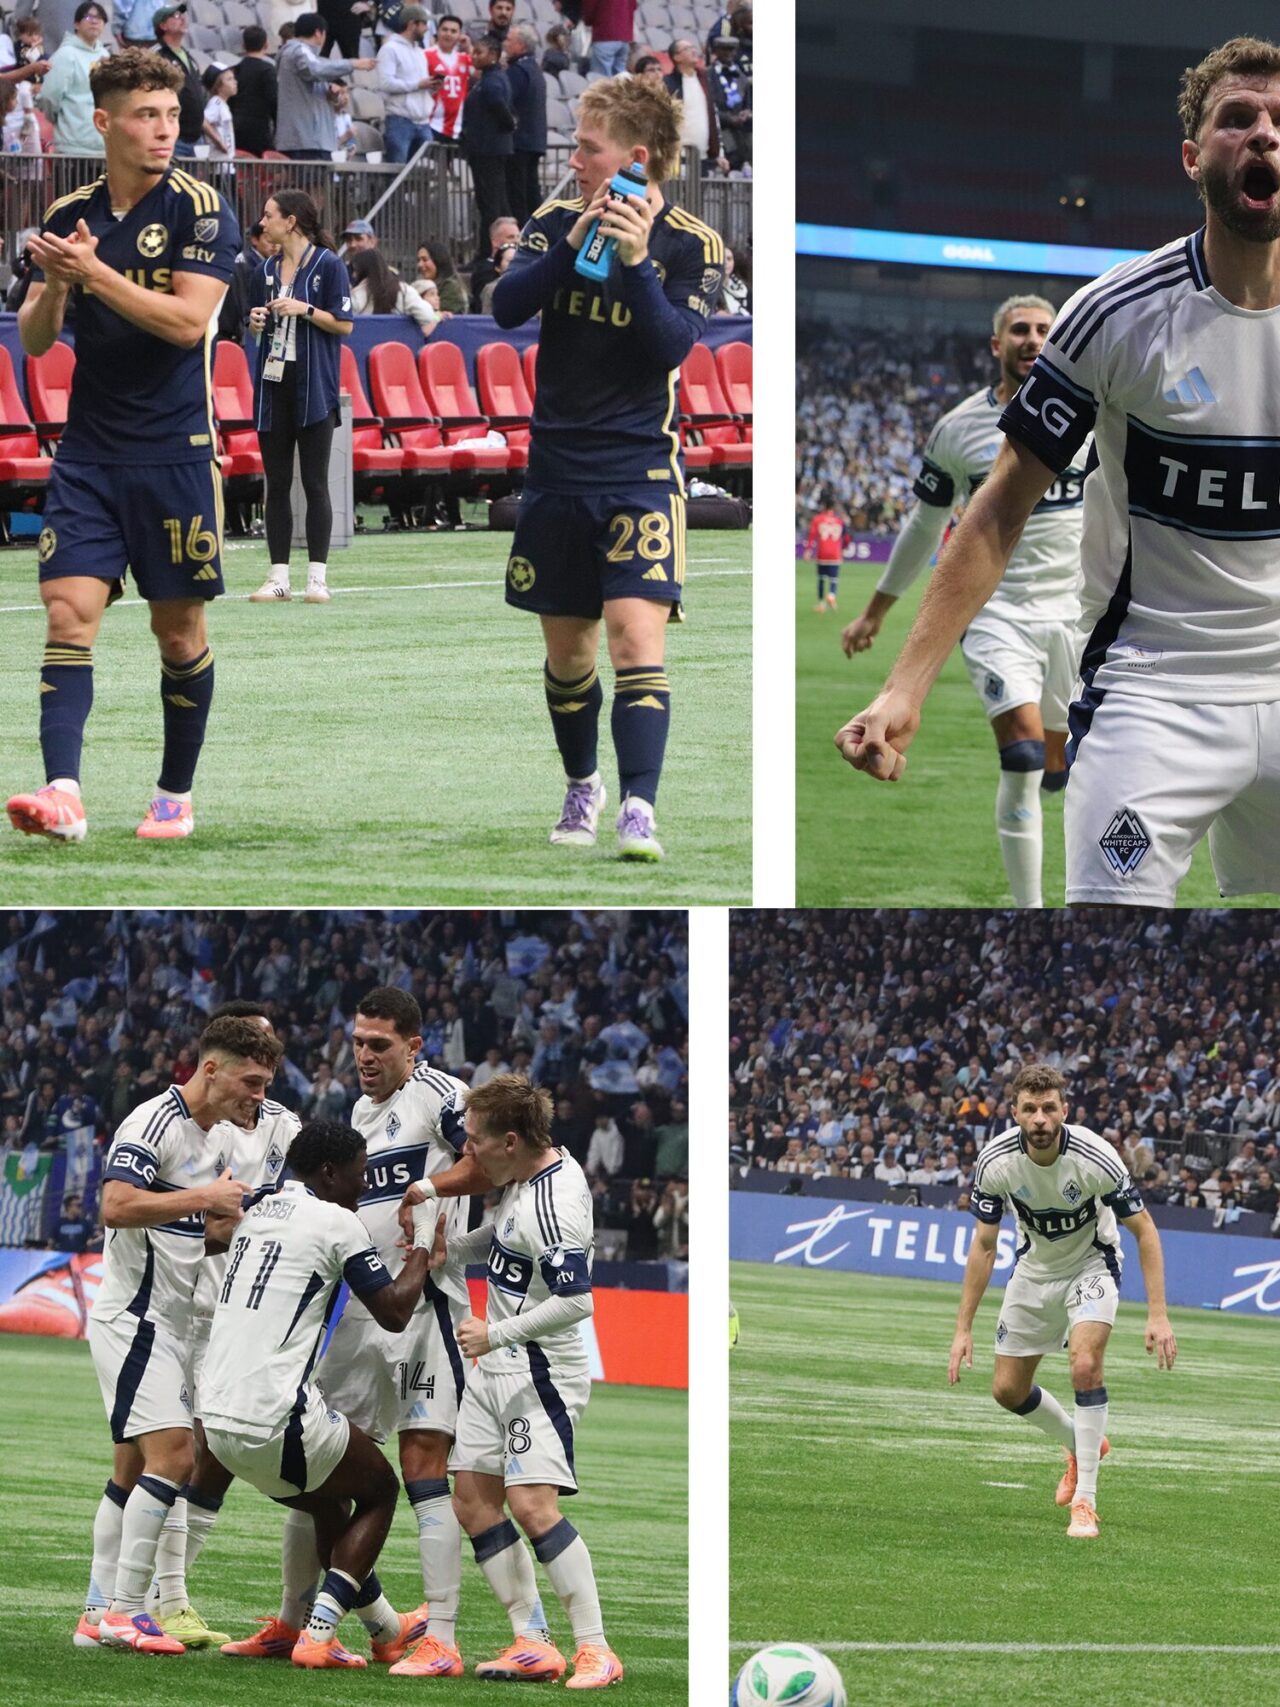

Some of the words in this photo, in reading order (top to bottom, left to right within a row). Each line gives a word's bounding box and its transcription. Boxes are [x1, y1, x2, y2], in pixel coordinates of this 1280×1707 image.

[1010, 376, 1077, 438] LG
[163, 515, 218, 563] 16
[607, 511, 672, 562] 28
[113, 1152, 157, 1185] BLG
[252, 1200, 297, 1220] SABBI
[1026, 1208, 1089, 1233] ELUS
[220, 1236, 282, 1310] 11
[1075, 1276, 1105, 1305] 13
[398, 1361, 435, 1400] 14
[503, 1417, 531, 1459] 8
